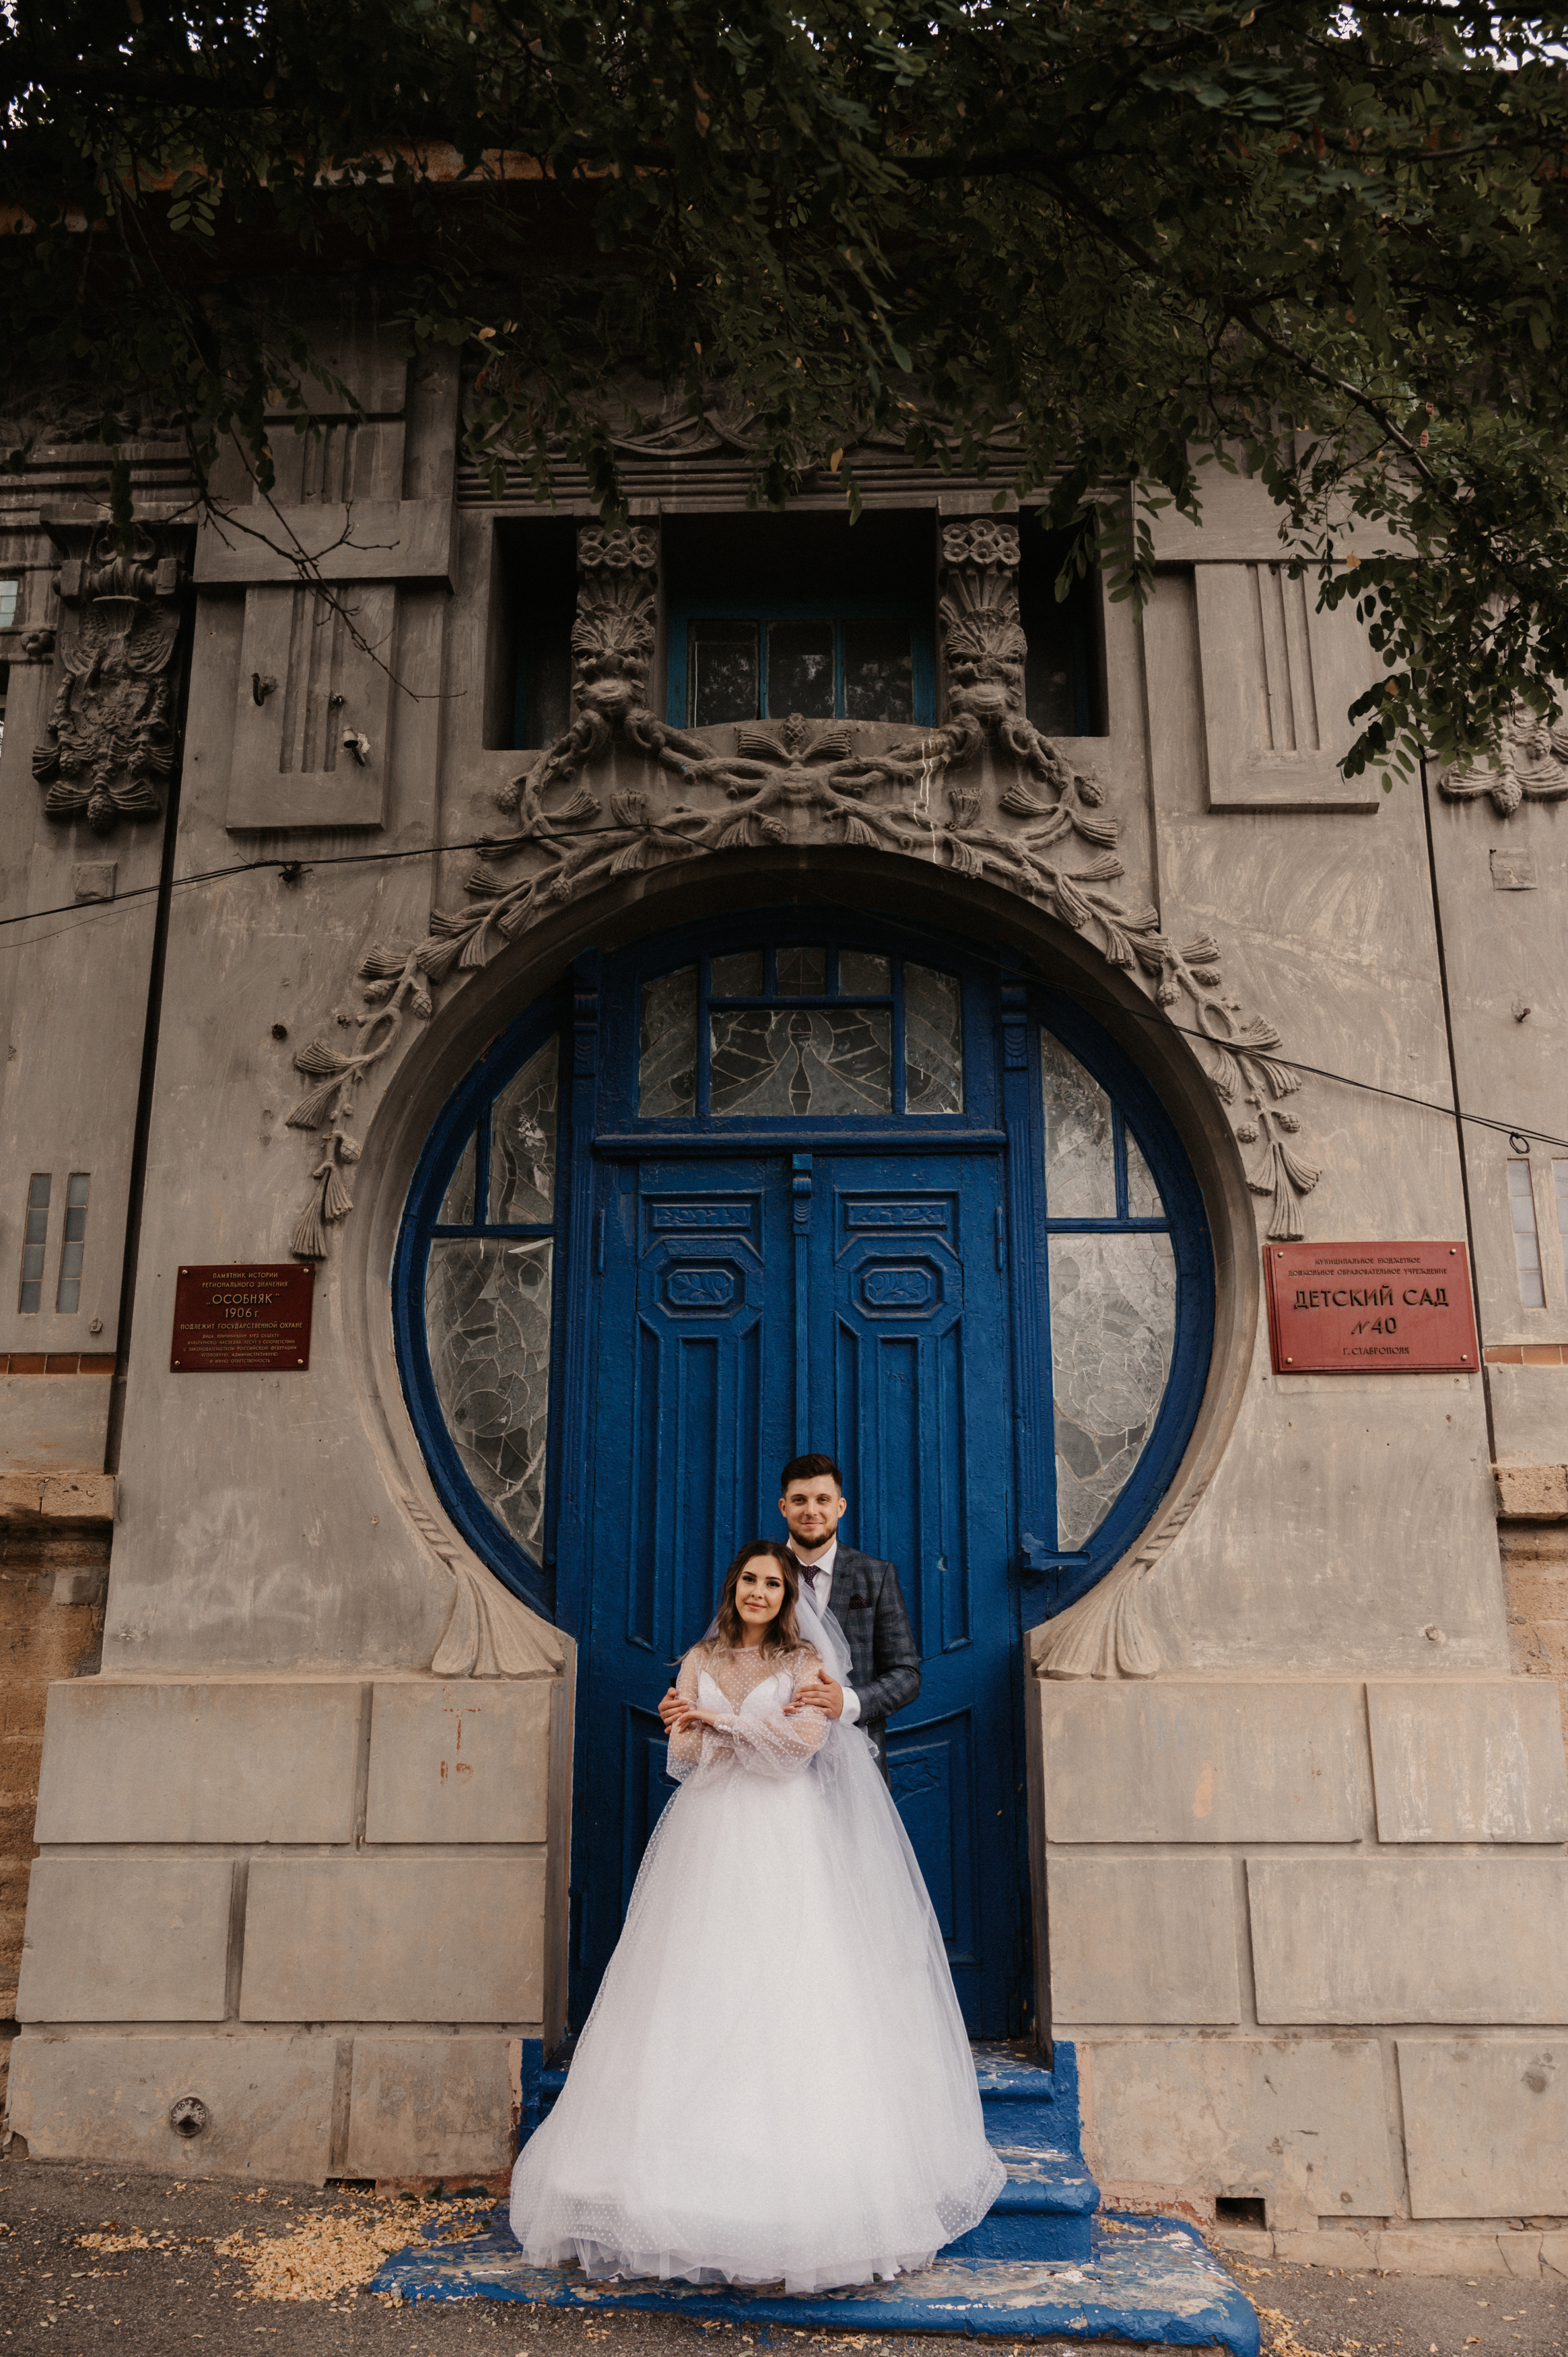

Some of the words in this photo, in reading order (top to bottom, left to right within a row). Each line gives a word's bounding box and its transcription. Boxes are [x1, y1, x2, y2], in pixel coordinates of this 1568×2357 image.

[1294, 1284, 1394, 1309] ДЕТСКИЙ
[1403, 1287, 1450, 1307] САД
[226, 1308, 252, 1318] 1906
[217, 1321, 277, 1329] ГОСУДАРСТВЕННОЙ
[1352, 1347, 1410, 1356] СТАВРОПОЛЯ
